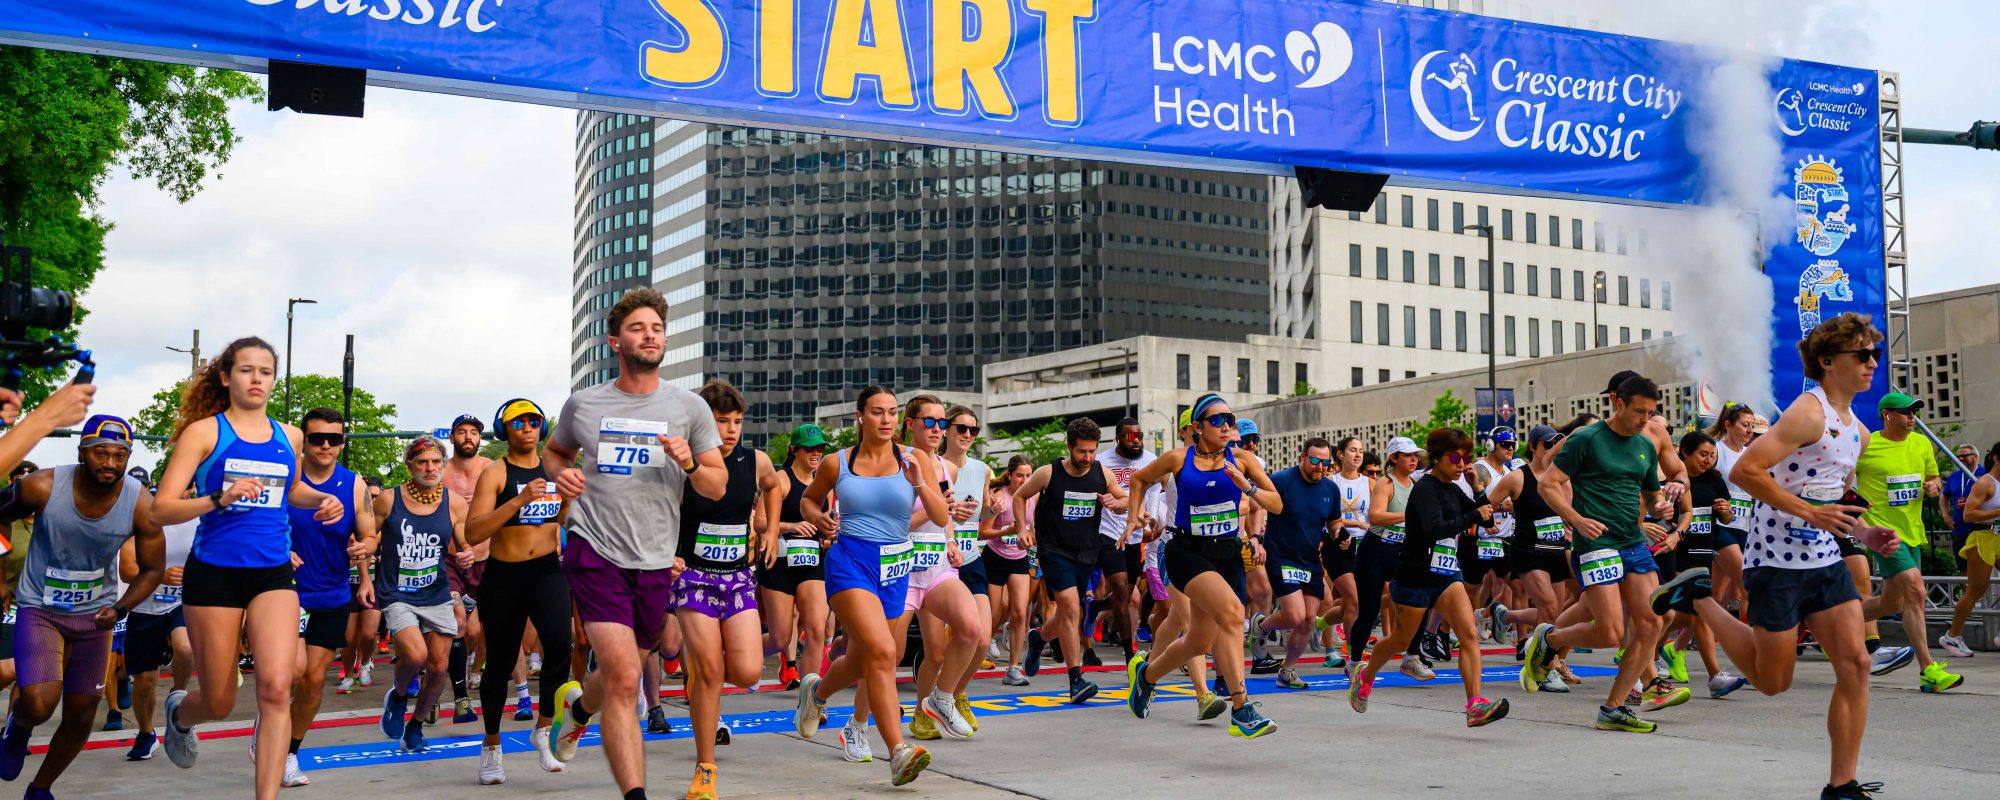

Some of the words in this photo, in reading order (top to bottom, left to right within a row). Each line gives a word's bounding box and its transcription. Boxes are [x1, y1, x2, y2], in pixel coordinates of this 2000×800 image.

[641, 0, 1097, 126] START
[1151, 31, 1277, 84] LCMC
[1490, 57, 1620, 103] Crescent
[1621, 71, 1682, 120] City
[1809, 82, 1829, 92] LCMC
[1829, 85, 1853, 95] Health
[1152, 84, 1296, 137] Health
[1807, 97, 1847, 114] Crescent
[1847, 102, 1867, 118] City
[1808, 112, 1851, 131] Classic
[1494, 99, 1646, 161] Classic
[614, 446, 650, 465] 776
[1894, 489, 1919, 500] 1612
[1067, 506, 1092, 516] 2332
[1198, 521, 1232, 537] 1776
[1685, 522, 1712, 534] 2349
[415, 532, 441, 547] NO
[396, 543, 443, 558] WHITE
[701, 545, 739, 560] 2013
[1482, 547, 1501, 556] 2427
[793, 554, 817, 565] 2039
[913, 552, 940, 566] 1352
[405, 574, 433, 587] 1630
[1287, 570, 1308, 581] 1482
[1587, 566, 1619, 583] 1383
[52, 589, 94, 603] 2251
